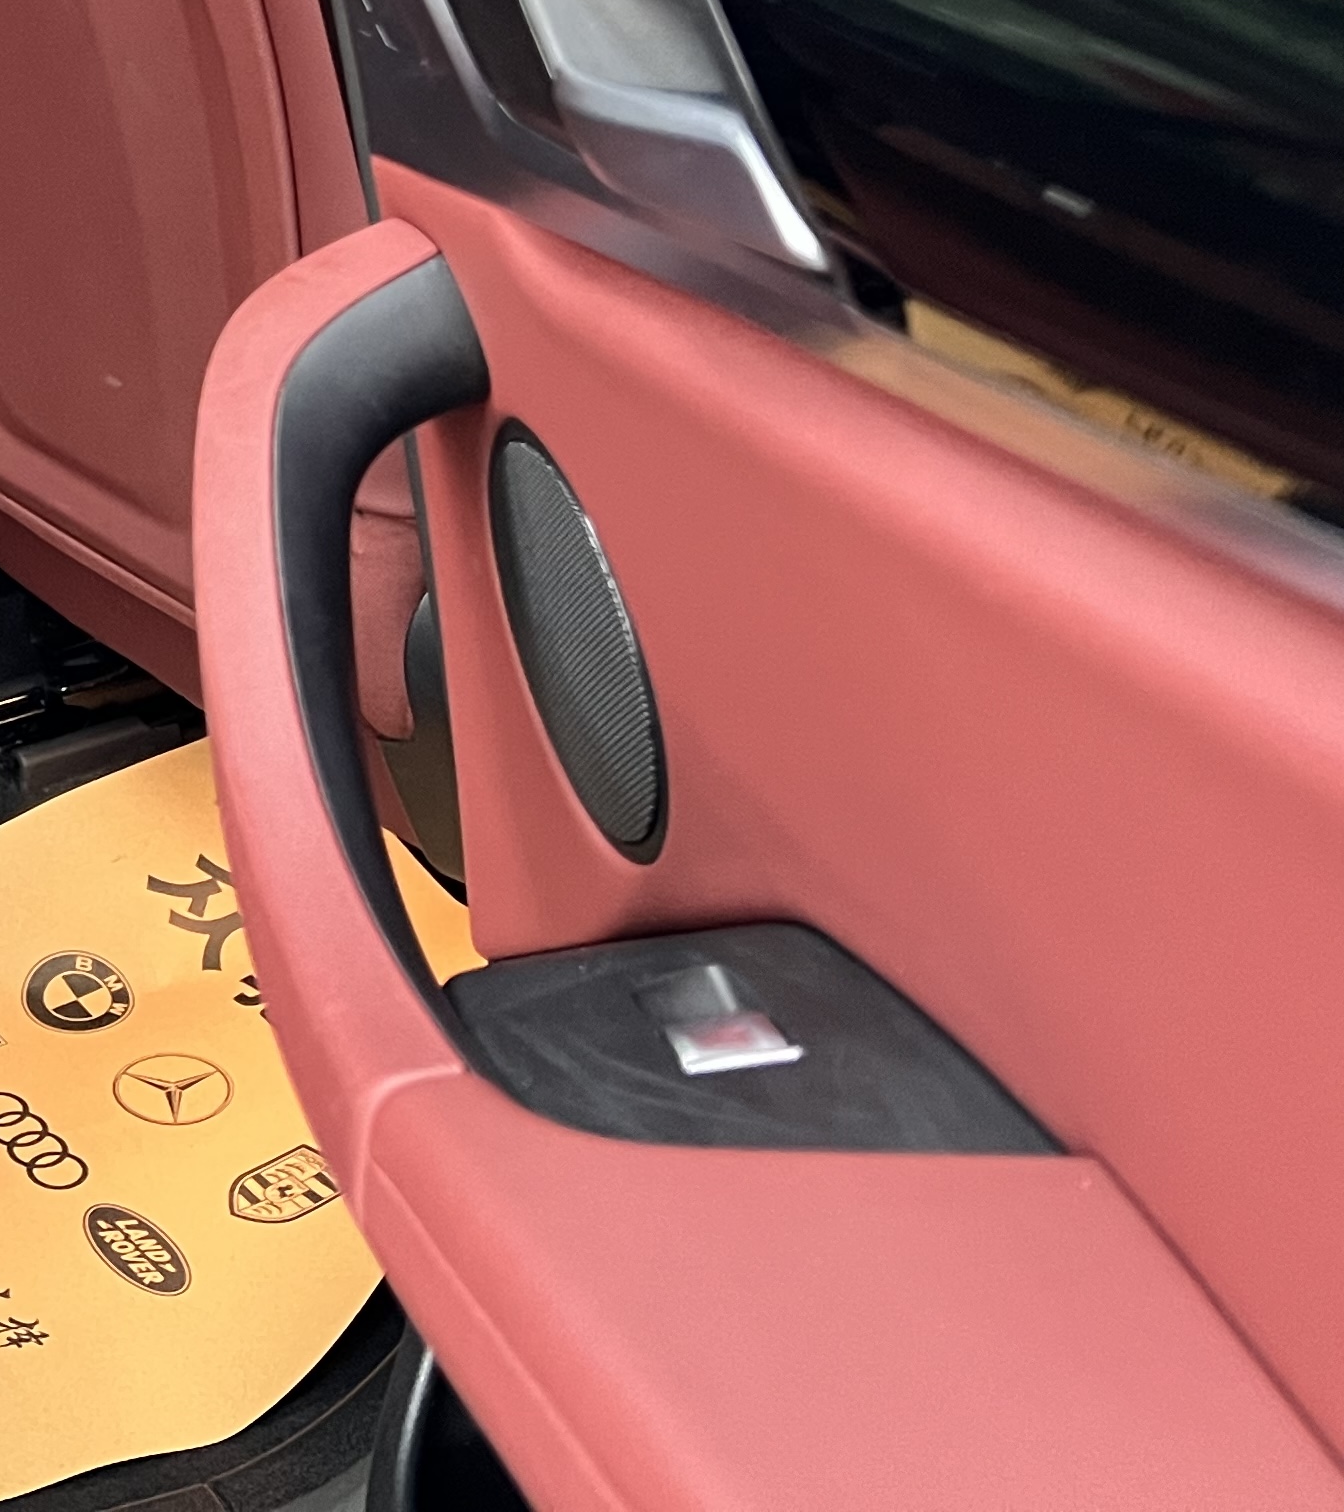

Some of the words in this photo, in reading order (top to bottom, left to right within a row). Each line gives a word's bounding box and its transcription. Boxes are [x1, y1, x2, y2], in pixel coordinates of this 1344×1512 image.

[75, 956, 129, 1016] BMW
[100, 1229, 165, 1285] ROVER
[115, 1219, 173, 1267] LAND
